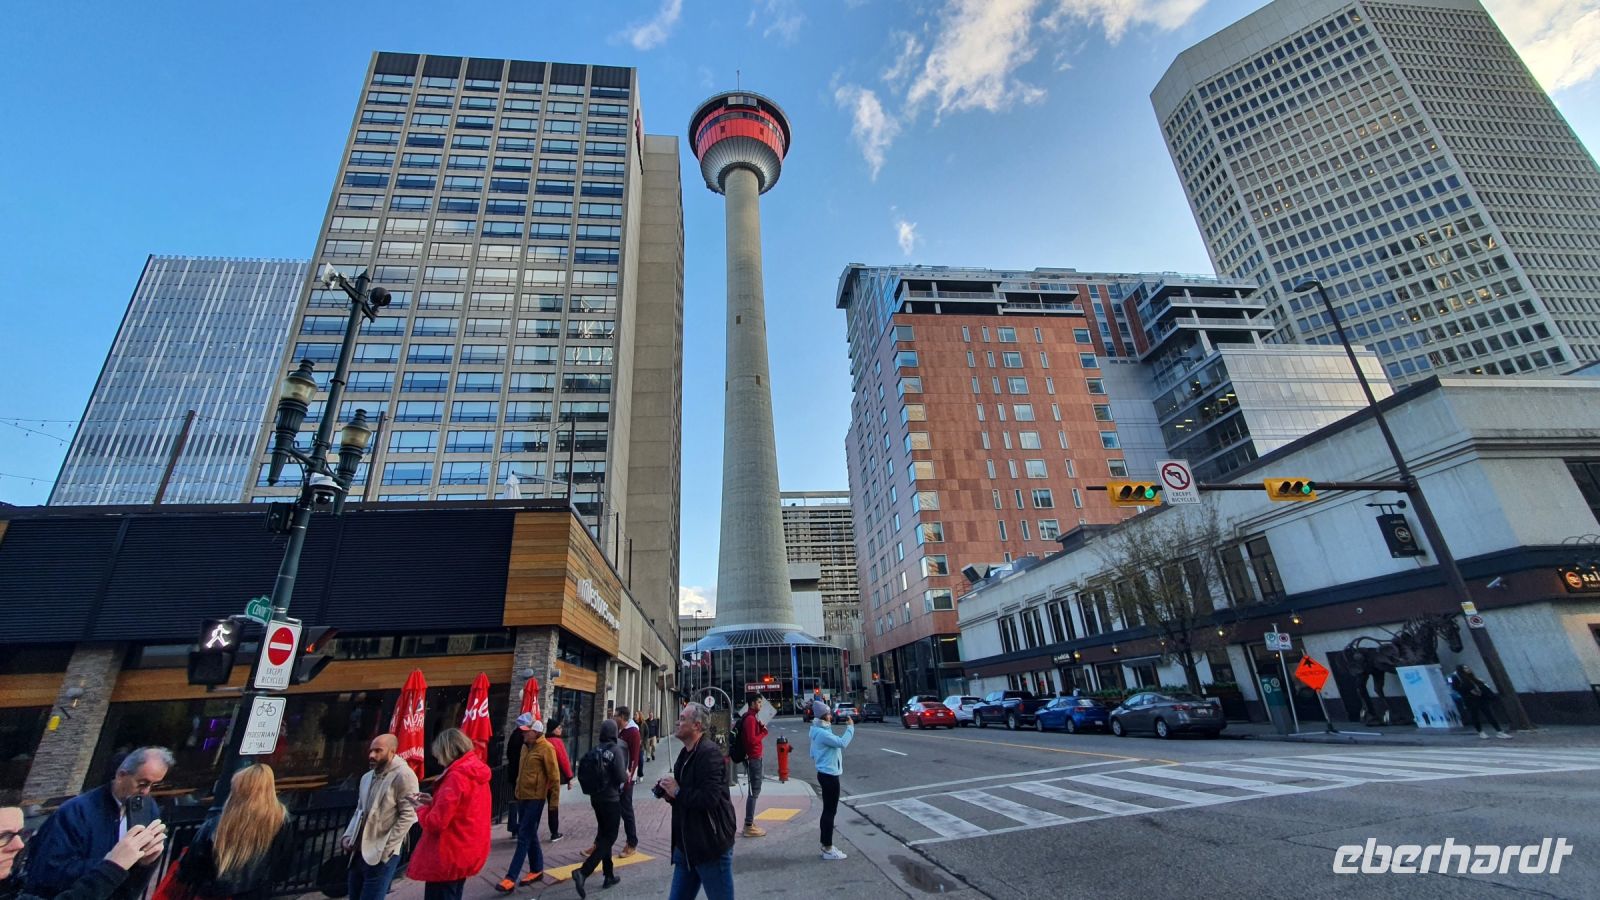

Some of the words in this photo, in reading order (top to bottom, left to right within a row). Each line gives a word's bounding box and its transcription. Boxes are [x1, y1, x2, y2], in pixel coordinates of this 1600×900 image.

[266, 667, 284, 676] EXCEPT
[260, 676, 284, 685] BICYCLES
[246, 731, 276, 739] PEDESTRIAN
[247, 741, 265, 749] SNAL
